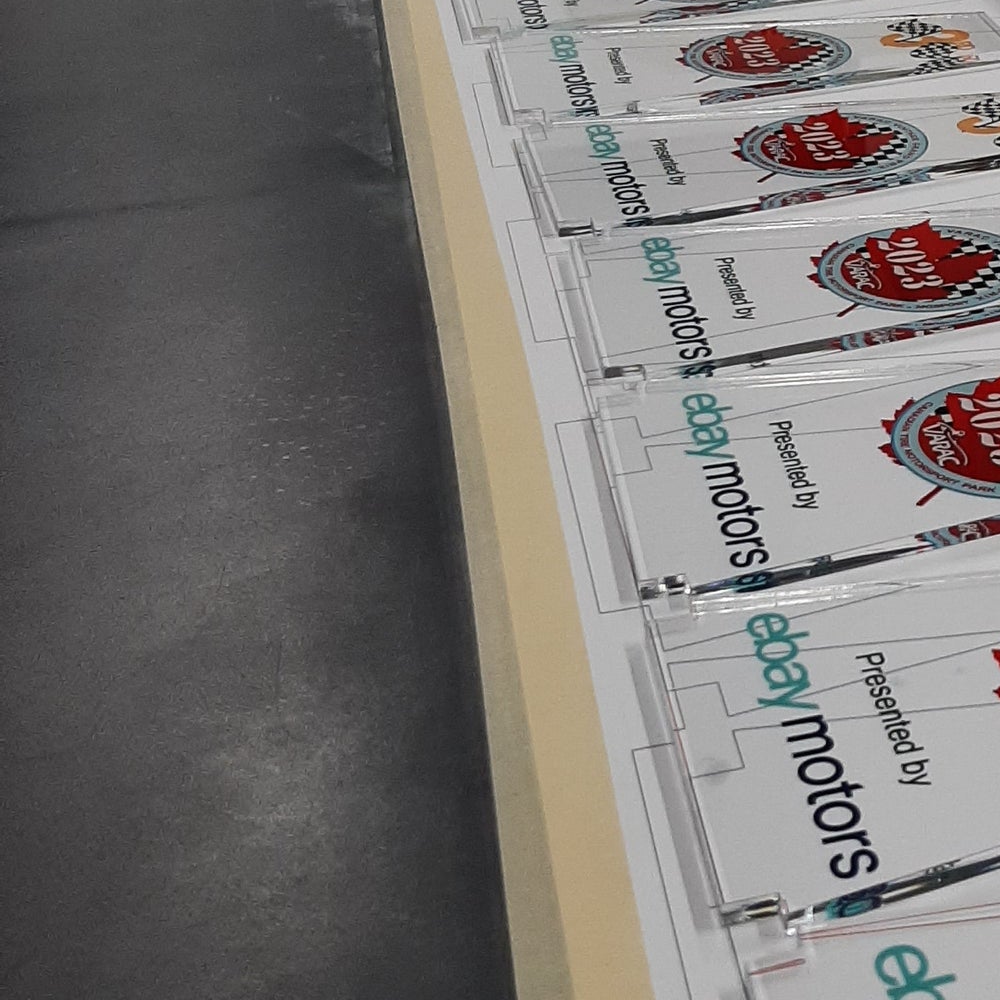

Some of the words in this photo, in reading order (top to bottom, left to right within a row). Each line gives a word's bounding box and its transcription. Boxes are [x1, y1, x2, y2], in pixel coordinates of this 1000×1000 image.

[733, 36, 780, 68] 2023
[585, 124, 625, 160] ebay
[792, 122, 851, 162] 2023
[601, 160, 650, 216] motors
[640, 236, 685, 284] ebay
[714, 257, 754, 306] Presented
[877, 236, 944, 290] 2023
[657, 285, 713, 360] motors
[732, 306, 757, 320] by
[682, 392, 735, 460] ebay
[922, 422, 961, 467] VARAC
[768, 420, 817, 489] Presented
[702, 460, 770, 568] motors
[792, 490, 820, 509] by
[746, 612, 820, 711] ebay
[855, 652, 926, 756] Presented
[897, 756, 932, 787] by
[781, 713, 880, 880] motors
[874, 944, 956, 1000] eb
